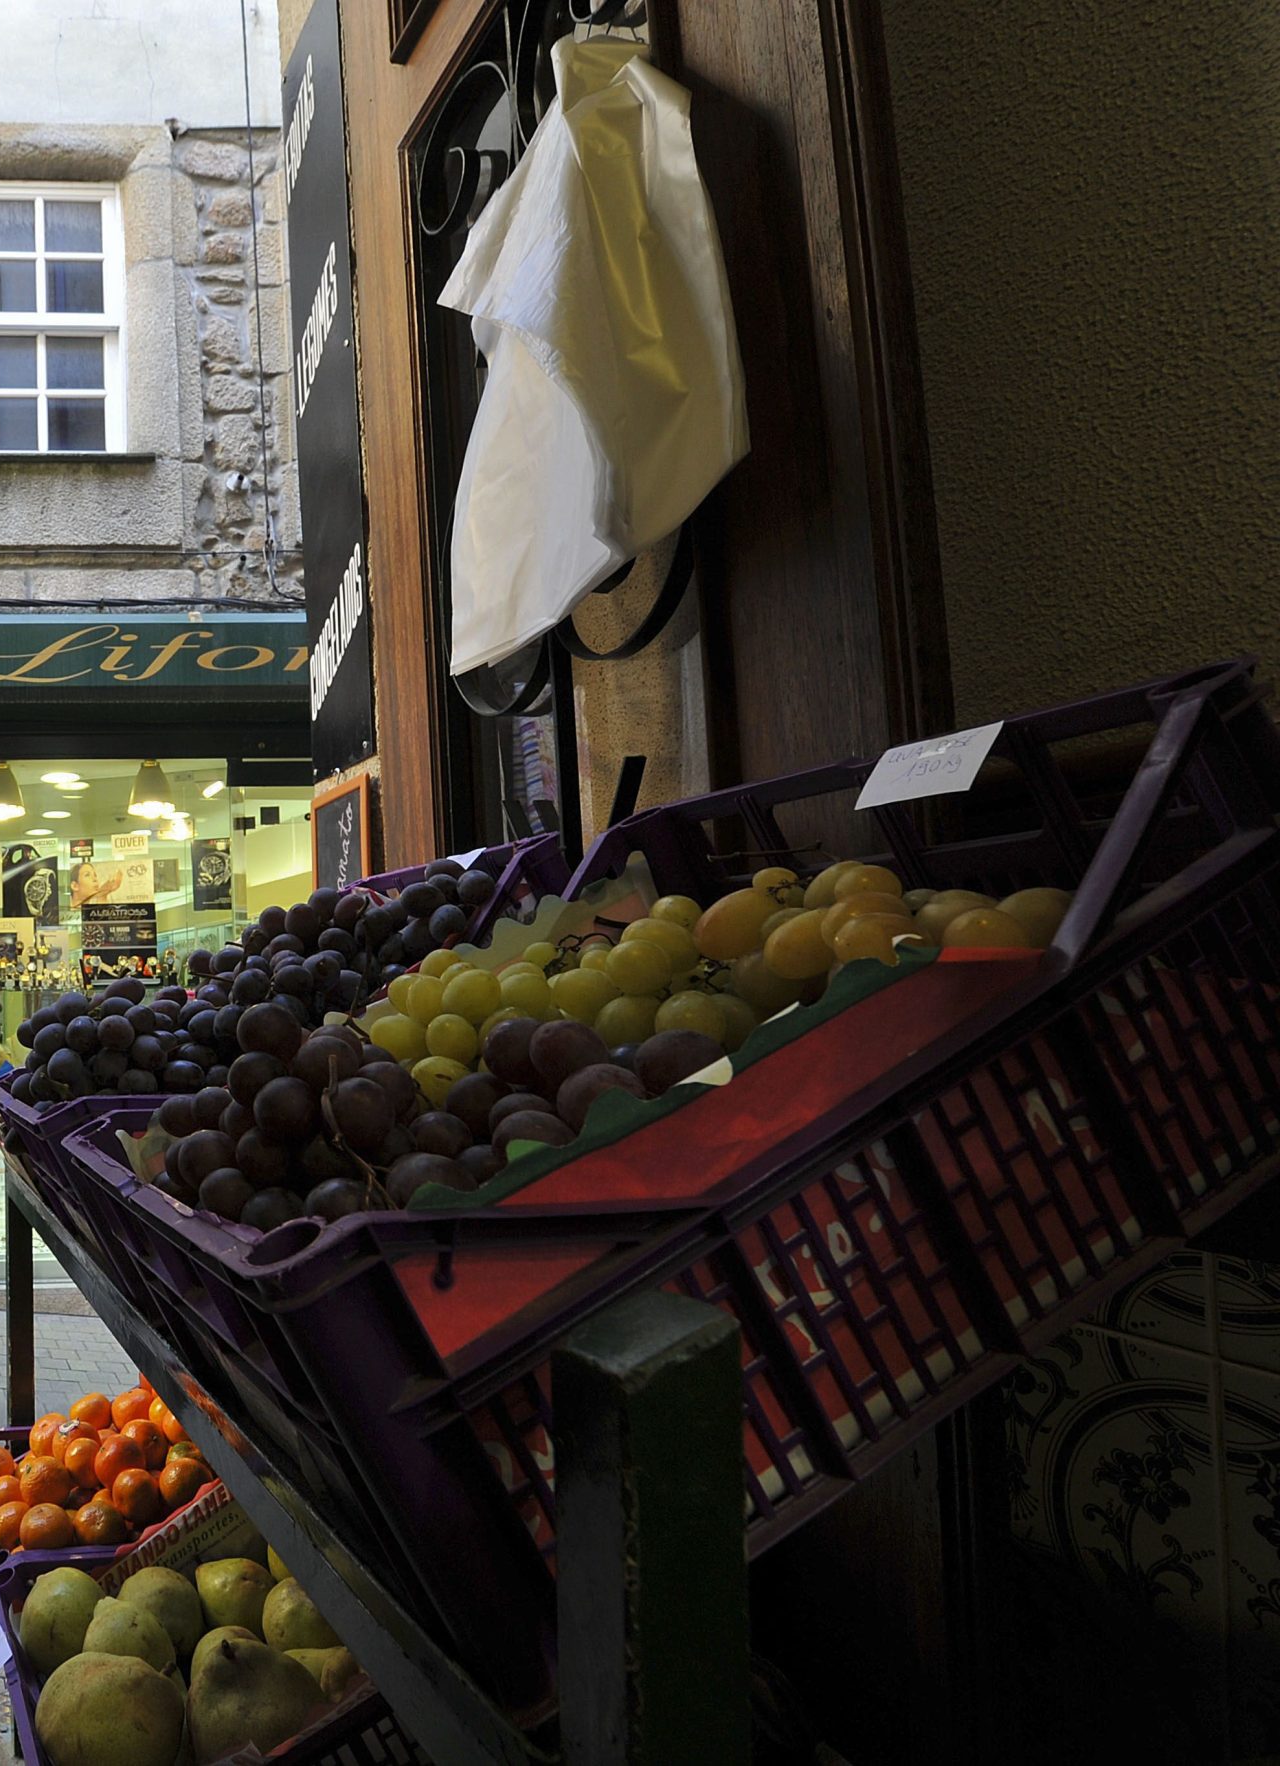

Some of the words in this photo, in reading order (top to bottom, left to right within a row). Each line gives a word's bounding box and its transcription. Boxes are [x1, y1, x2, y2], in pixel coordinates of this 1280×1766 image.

[285, 54, 315, 205] FRUTAS
[297, 241, 338, 419] LEGUMES
[310, 543, 363, 721] CONGELADOS
[114, 836, 145, 849] COVER
[182, 1485, 235, 1532] LAME
